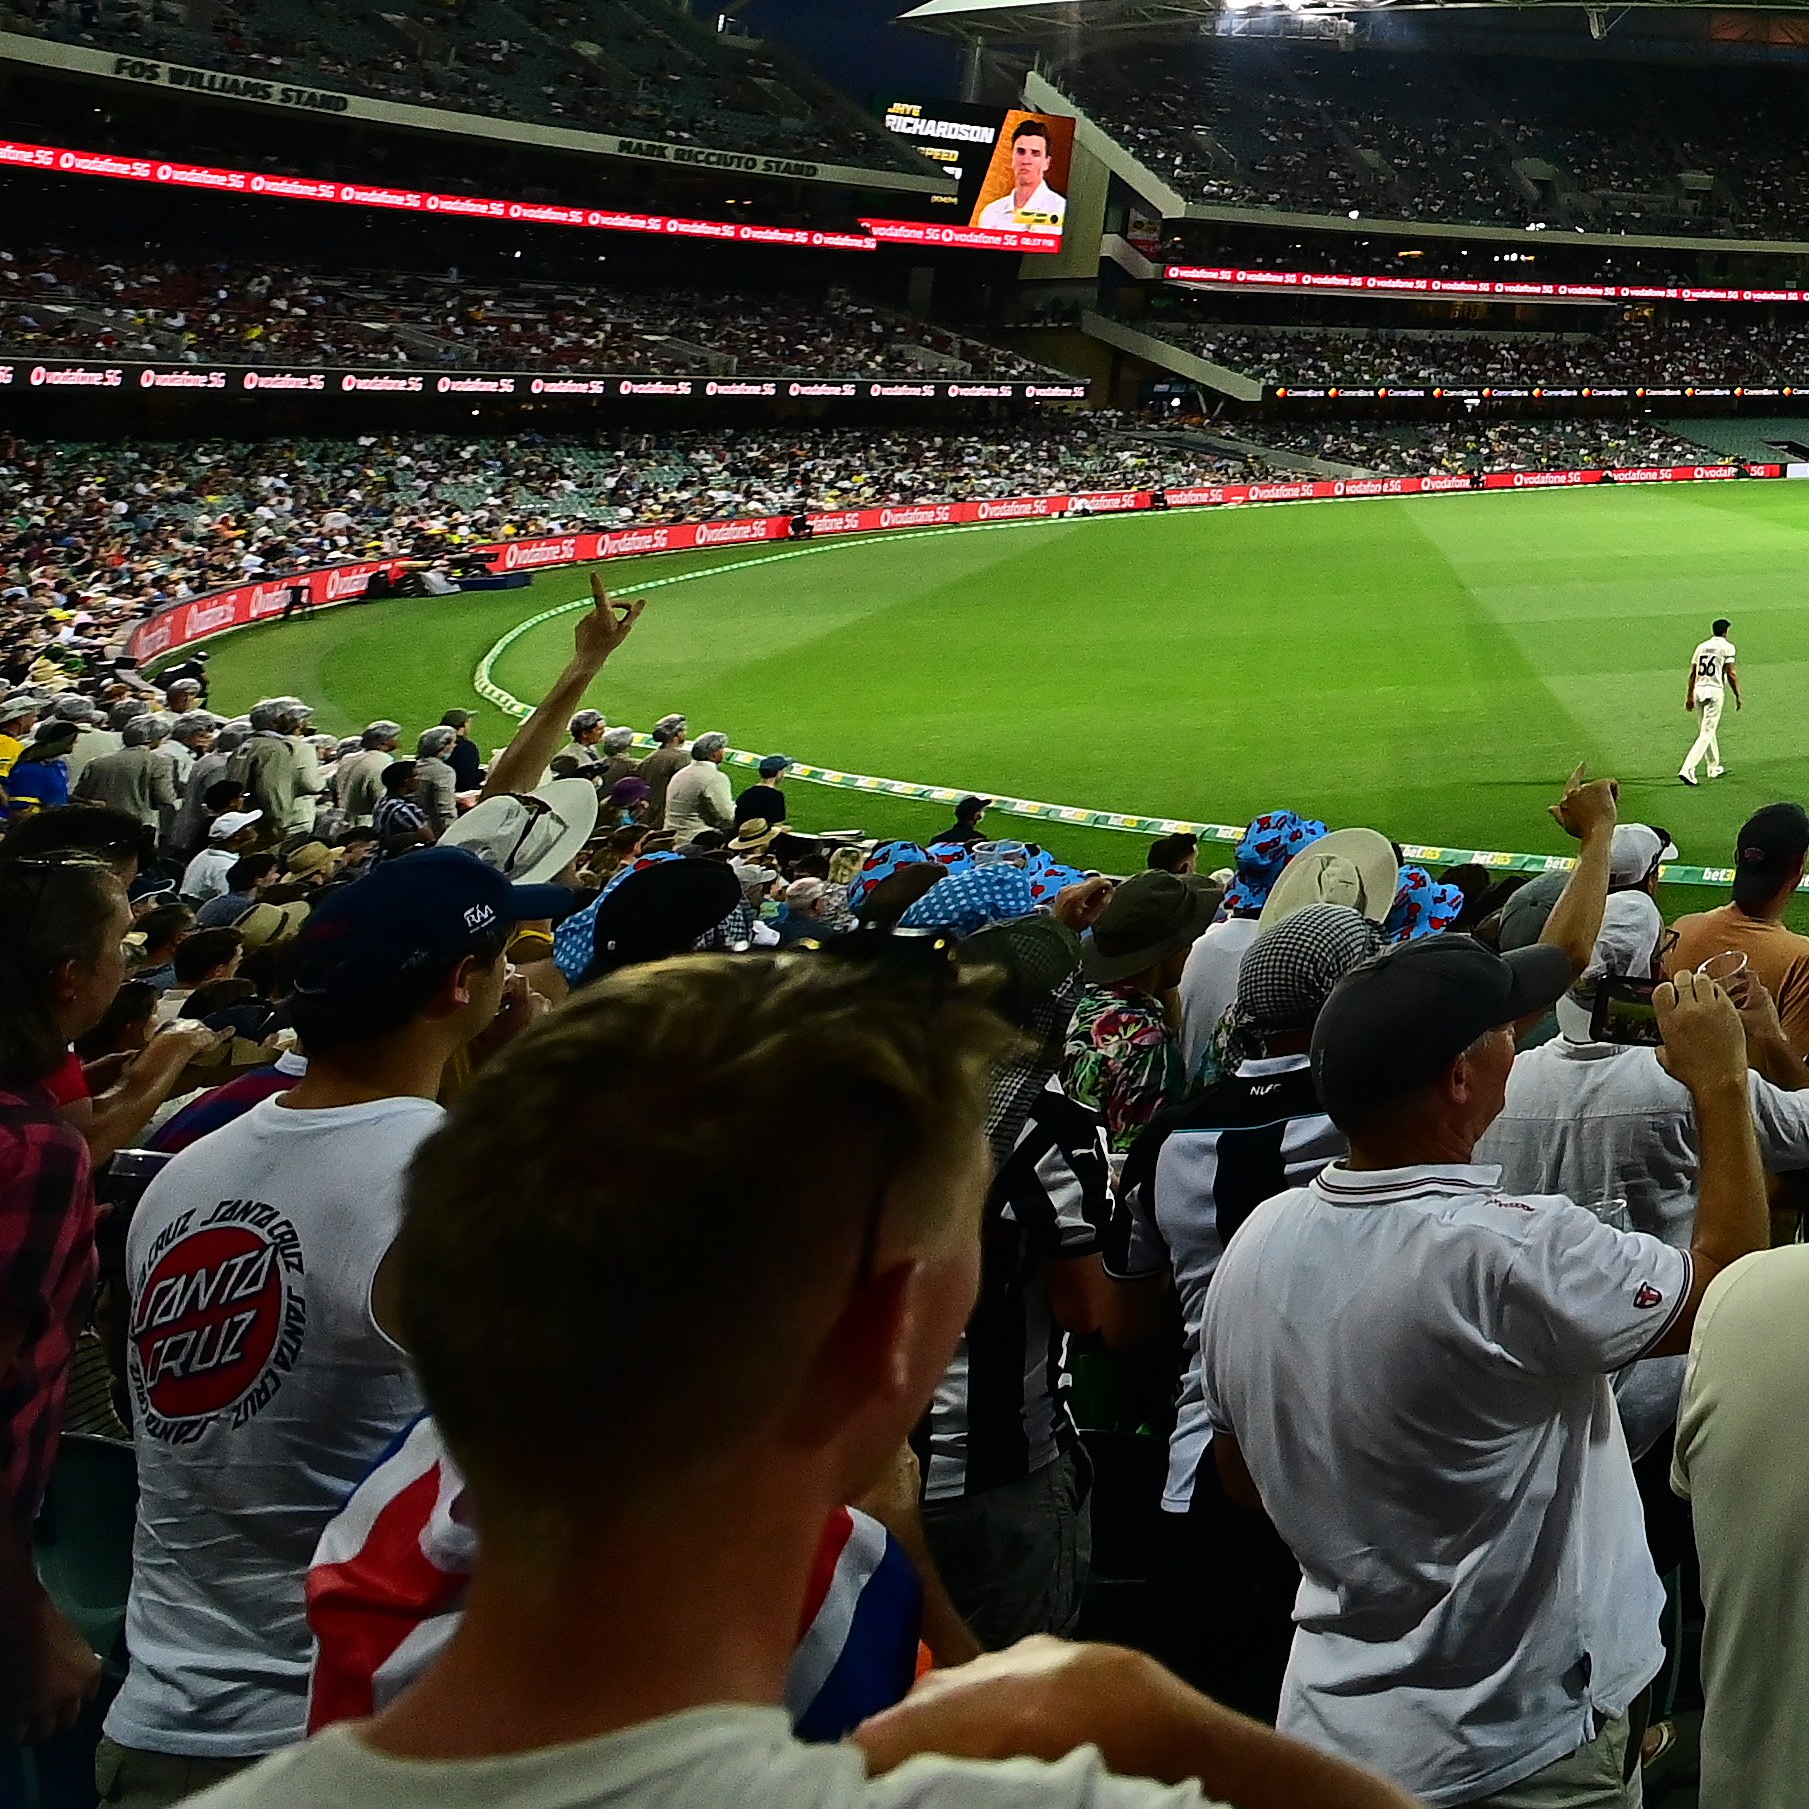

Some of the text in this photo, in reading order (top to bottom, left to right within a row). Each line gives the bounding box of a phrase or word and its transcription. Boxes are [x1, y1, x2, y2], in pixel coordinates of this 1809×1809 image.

[168, 66, 274, 100] WILLIAMS
[279, 88, 348, 111] STAND
[885, 114, 995, 144] RICHARDSON
[617, 140, 818, 178] MARK RICCIUTO STAND
[871, 226, 1017, 247] vodafone 5G vodafone 5G
[1522, 472, 1582, 486] vodafone 5G
[1612, 466, 1672, 481] vodafone 5G
[1750, 465, 1765, 477] 5G
[1166, 488, 1224, 505] vodafone 5G
[1258, 484, 1314, 499] vodafone 5G
[890, 505, 950, 525] vodafone 5G
[989, 499, 1048, 519] vodafone 5G
[1698, 655, 1716, 677] 56
[1402, 844, 1441, 860] bet365
[1471, 850, 1512, 866] bet365
[147, 1207, 197, 1269] CRUZ
[200, 1199, 305, 1275] SANTA CRUZ
[131, 1241, 279, 1339] SANTA
[146, 1308, 259, 1389] CRUZ
[231, 1285, 306, 1431] SANTA CRUZ
[145, 1412, 219, 1446] SANTA
